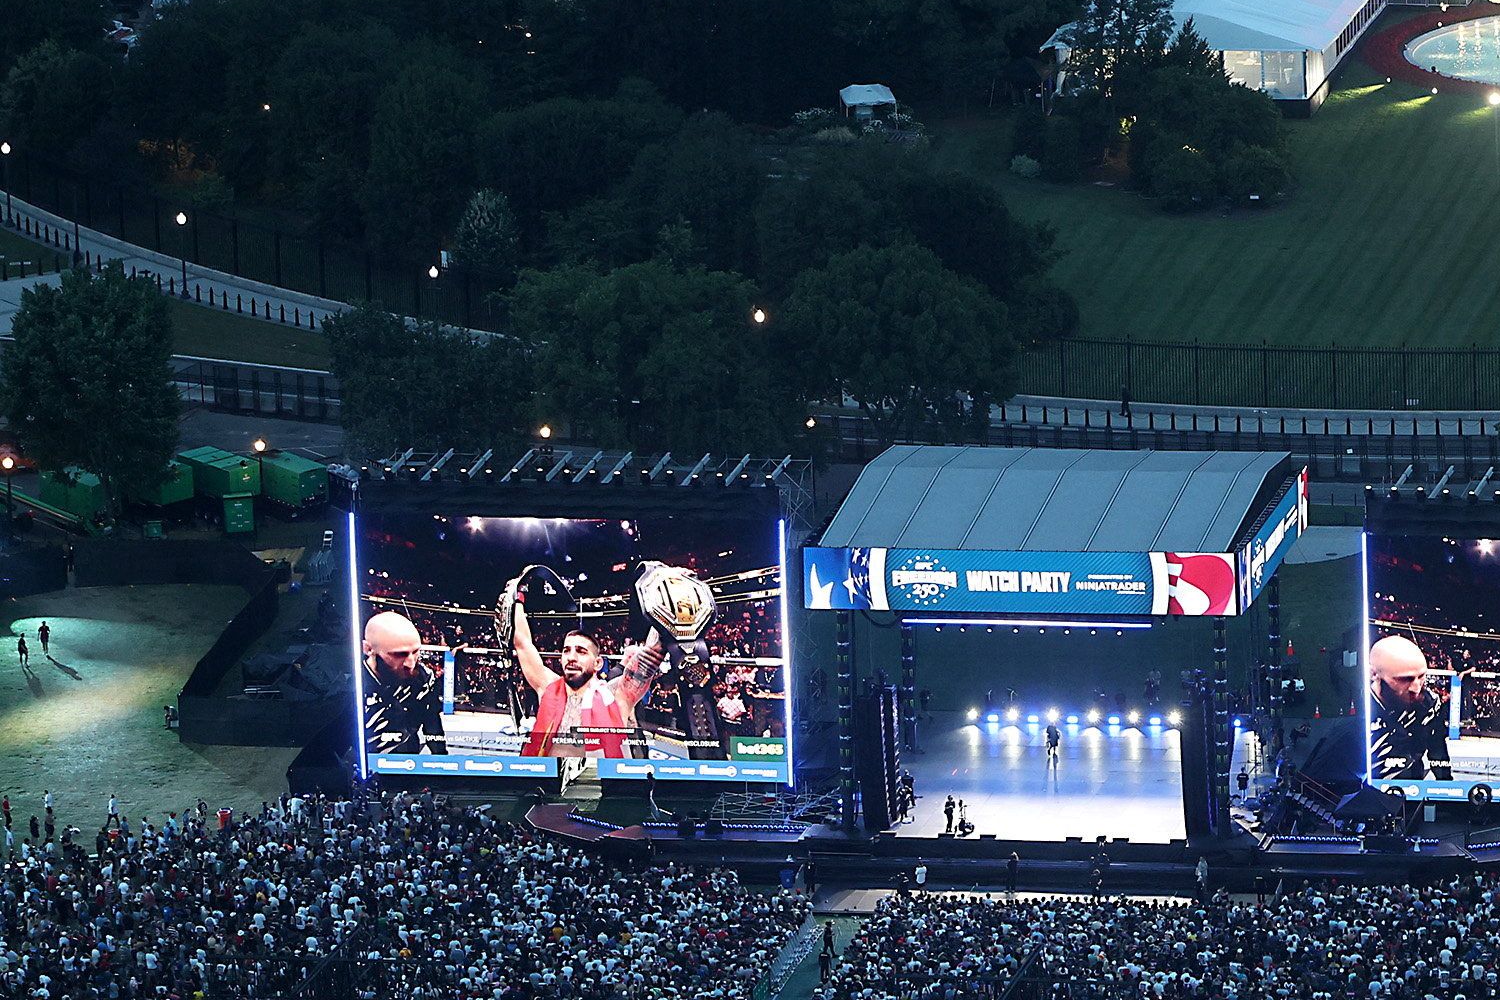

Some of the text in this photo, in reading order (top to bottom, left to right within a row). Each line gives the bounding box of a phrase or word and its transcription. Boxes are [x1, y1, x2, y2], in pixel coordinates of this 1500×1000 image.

[965, 570, 1071, 593] WATCH PARTY
[1075, 580, 1146, 592] NINJATRADER
[912, 583, 940, 599] 250
[737, 742, 784, 755] bet365
